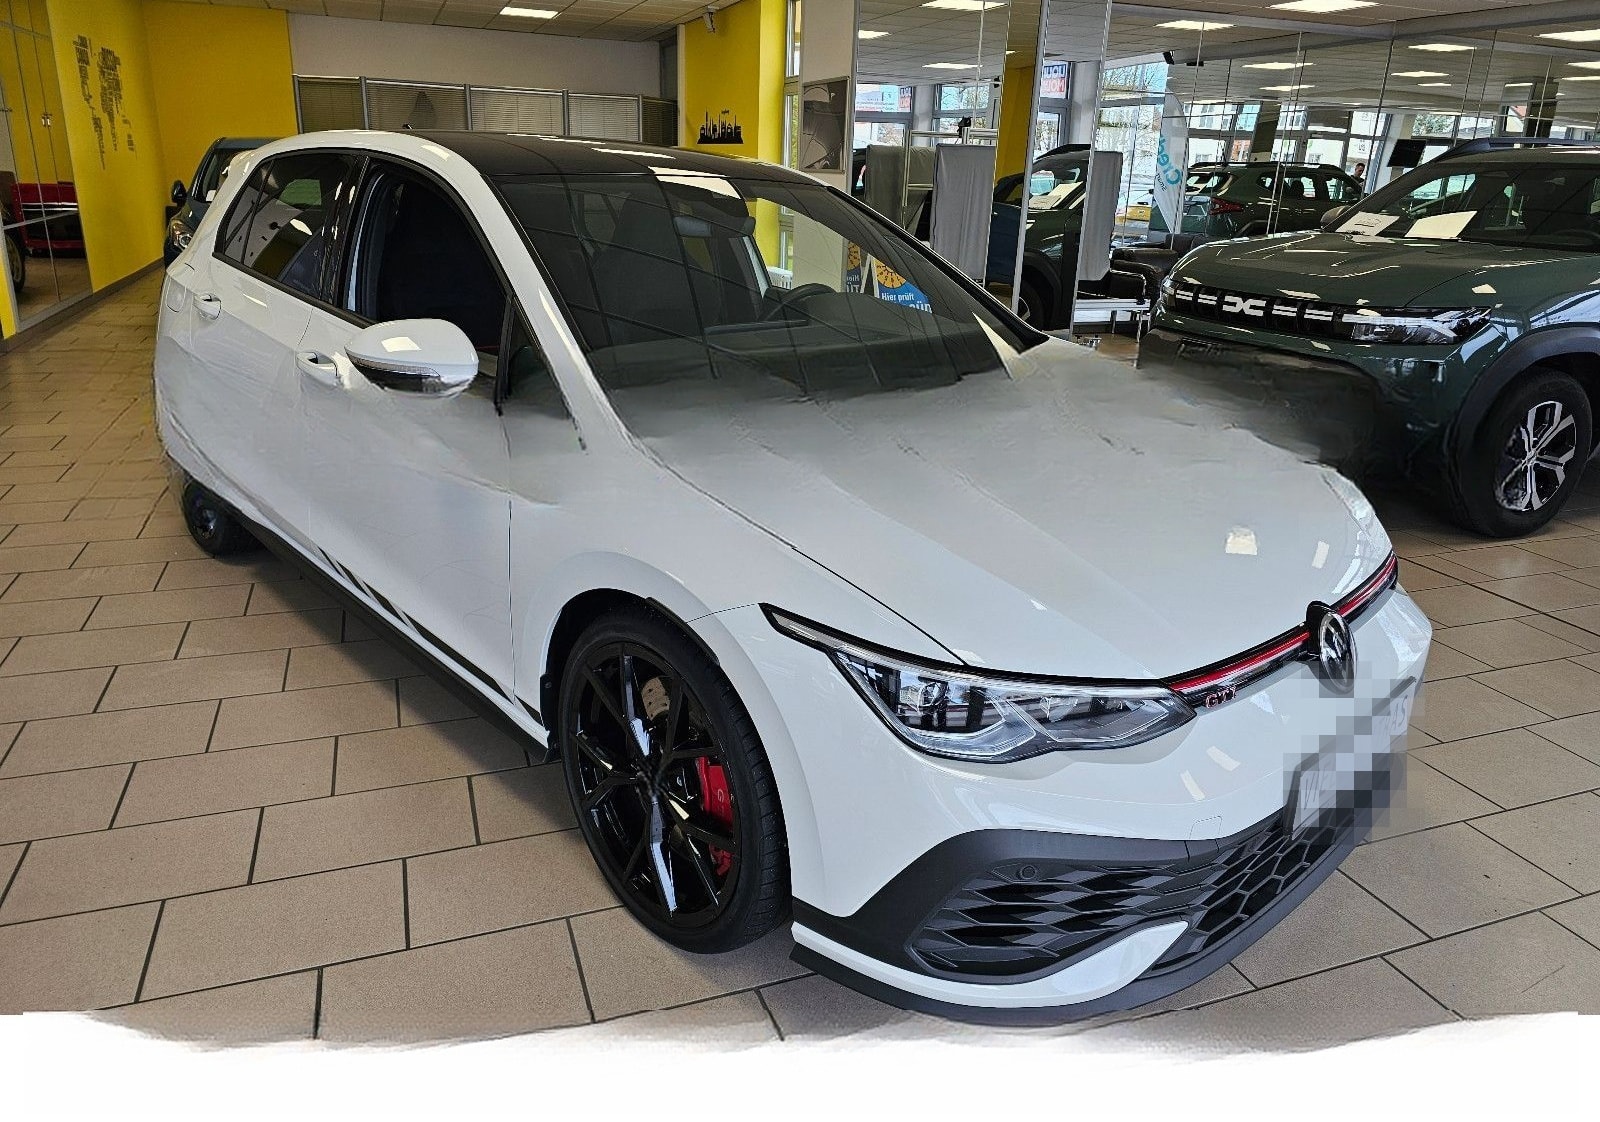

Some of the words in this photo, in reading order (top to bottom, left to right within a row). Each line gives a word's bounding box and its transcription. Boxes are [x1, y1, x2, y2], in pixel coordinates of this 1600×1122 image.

[881, 292, 897, 301] Hier
[897, 292, 915, 303] prüft
[1205, 685, 1237, 709] GTI
